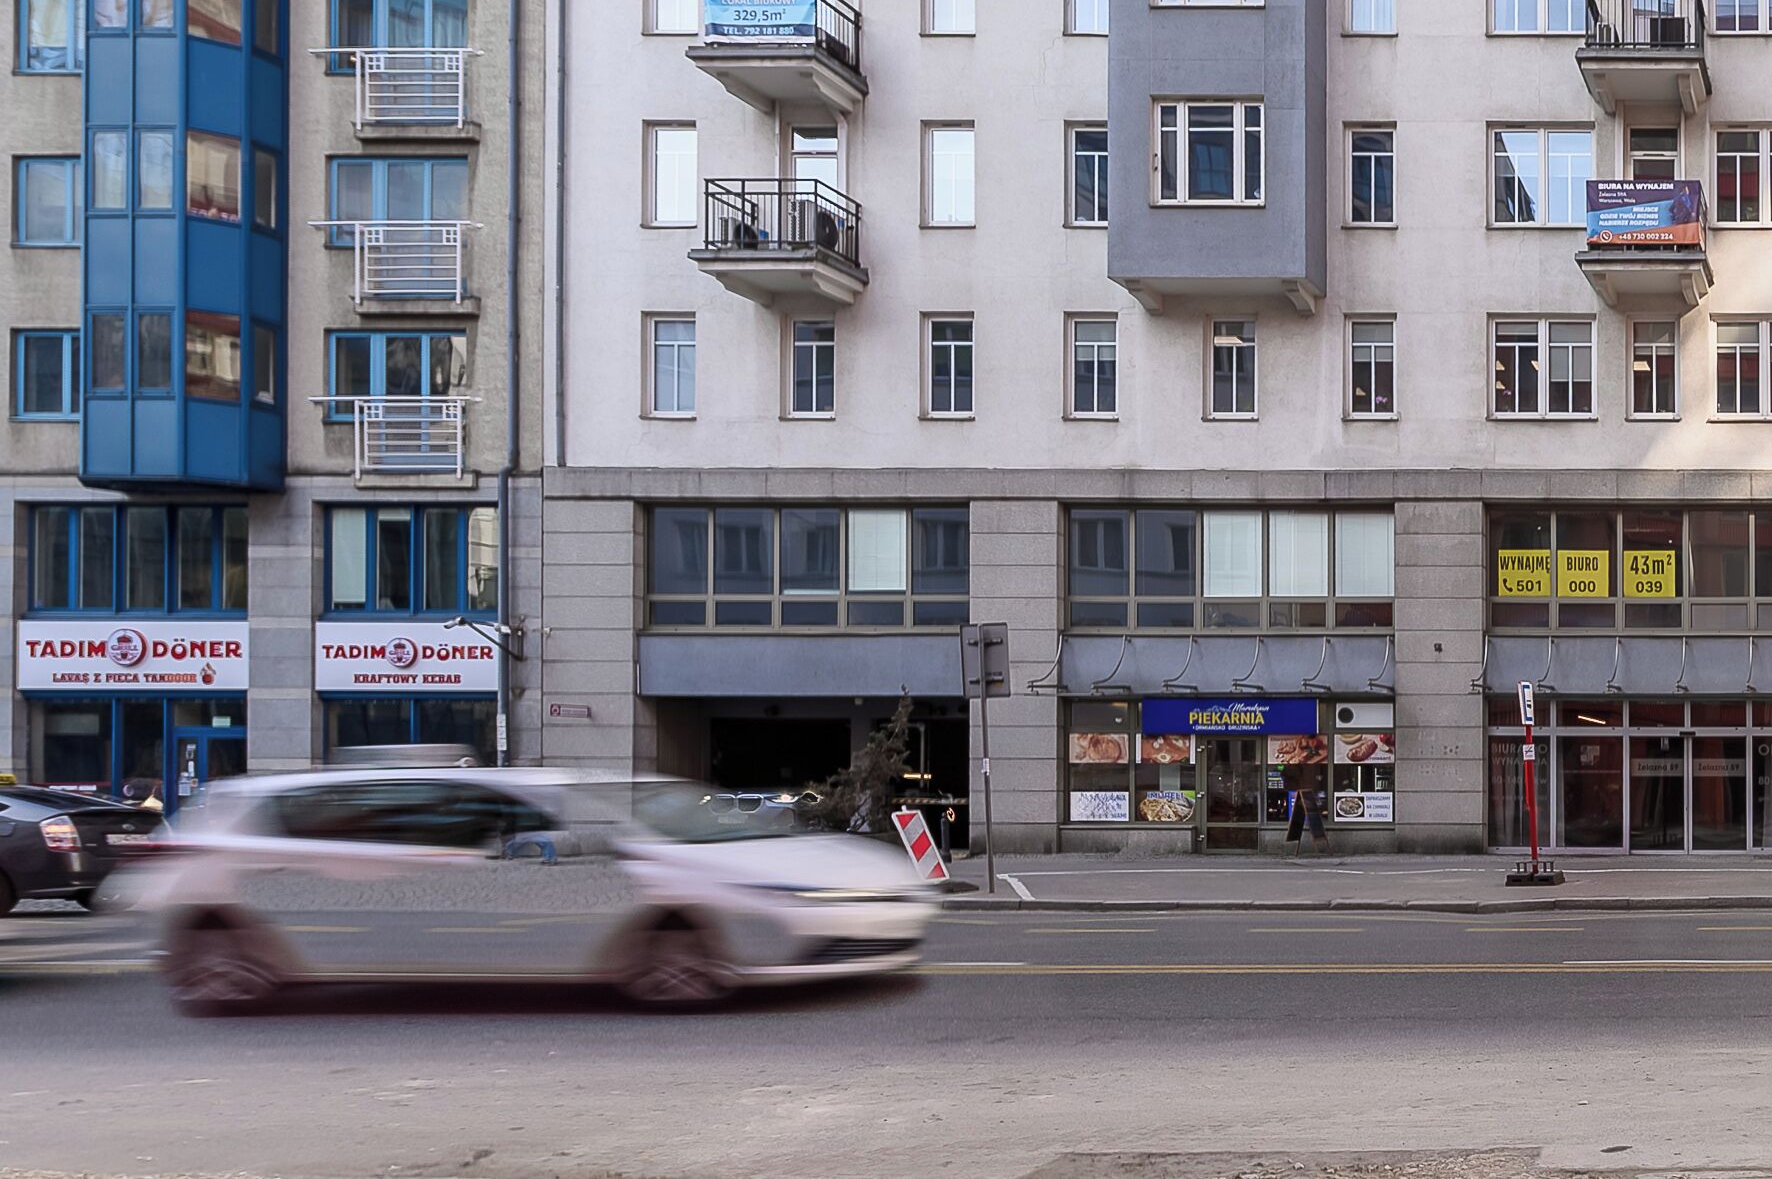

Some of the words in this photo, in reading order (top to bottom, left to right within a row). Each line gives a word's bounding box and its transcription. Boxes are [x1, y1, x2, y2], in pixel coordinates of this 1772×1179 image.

[723, 26, 742, 35] TEL.
[762, 26, 777, 35] 181
[1500, 556, 1551, 574] WYNAJMĘ
[1566, 556, 1599, 571] BIURO
[1517, 580, 1542, 592] 501
[1569, 581, 1596, 593] 000
[1635, 581, 1663, 593] 039
[26, 640, 107, 659] TADIM
[152, 638, 242, 660] DÖNER
[322, 645, 387, 659] TADIM
[422, 643, 493, 661] DÖNER
[93, 673, 102, 683] Z
[105, 673, 140, 683] PIECA
[353, 674, 418, 684] KRAFTOWY
[422, 674, 461, 684] KEBAB
[1189, 712, 1265, 725] PIEKARNIA
